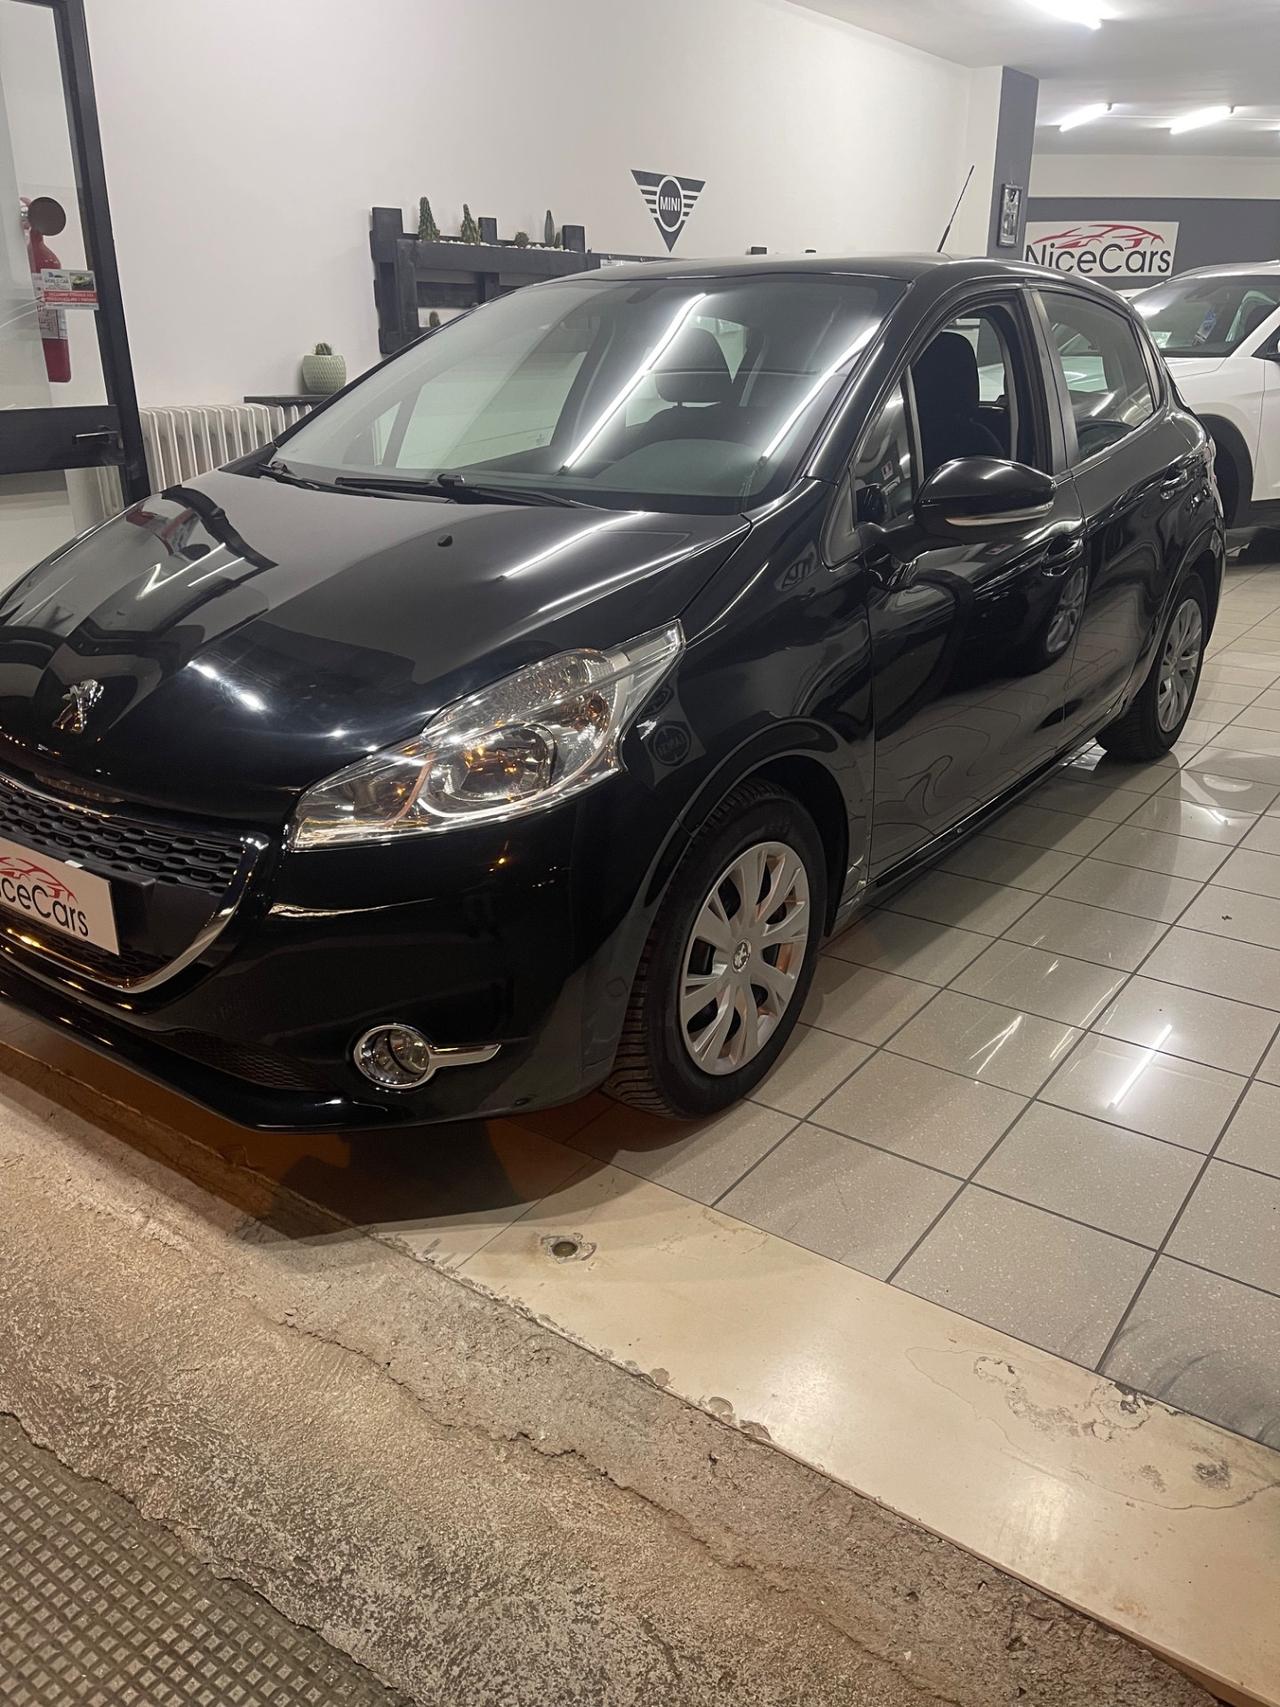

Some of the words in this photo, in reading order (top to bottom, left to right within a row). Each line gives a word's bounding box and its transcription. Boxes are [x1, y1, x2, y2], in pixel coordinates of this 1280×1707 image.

[660, 196, 681, 212] MINI
[1025, 243, 1172, 274] NiceCars
[0, 878, 88, 937] ceCars
